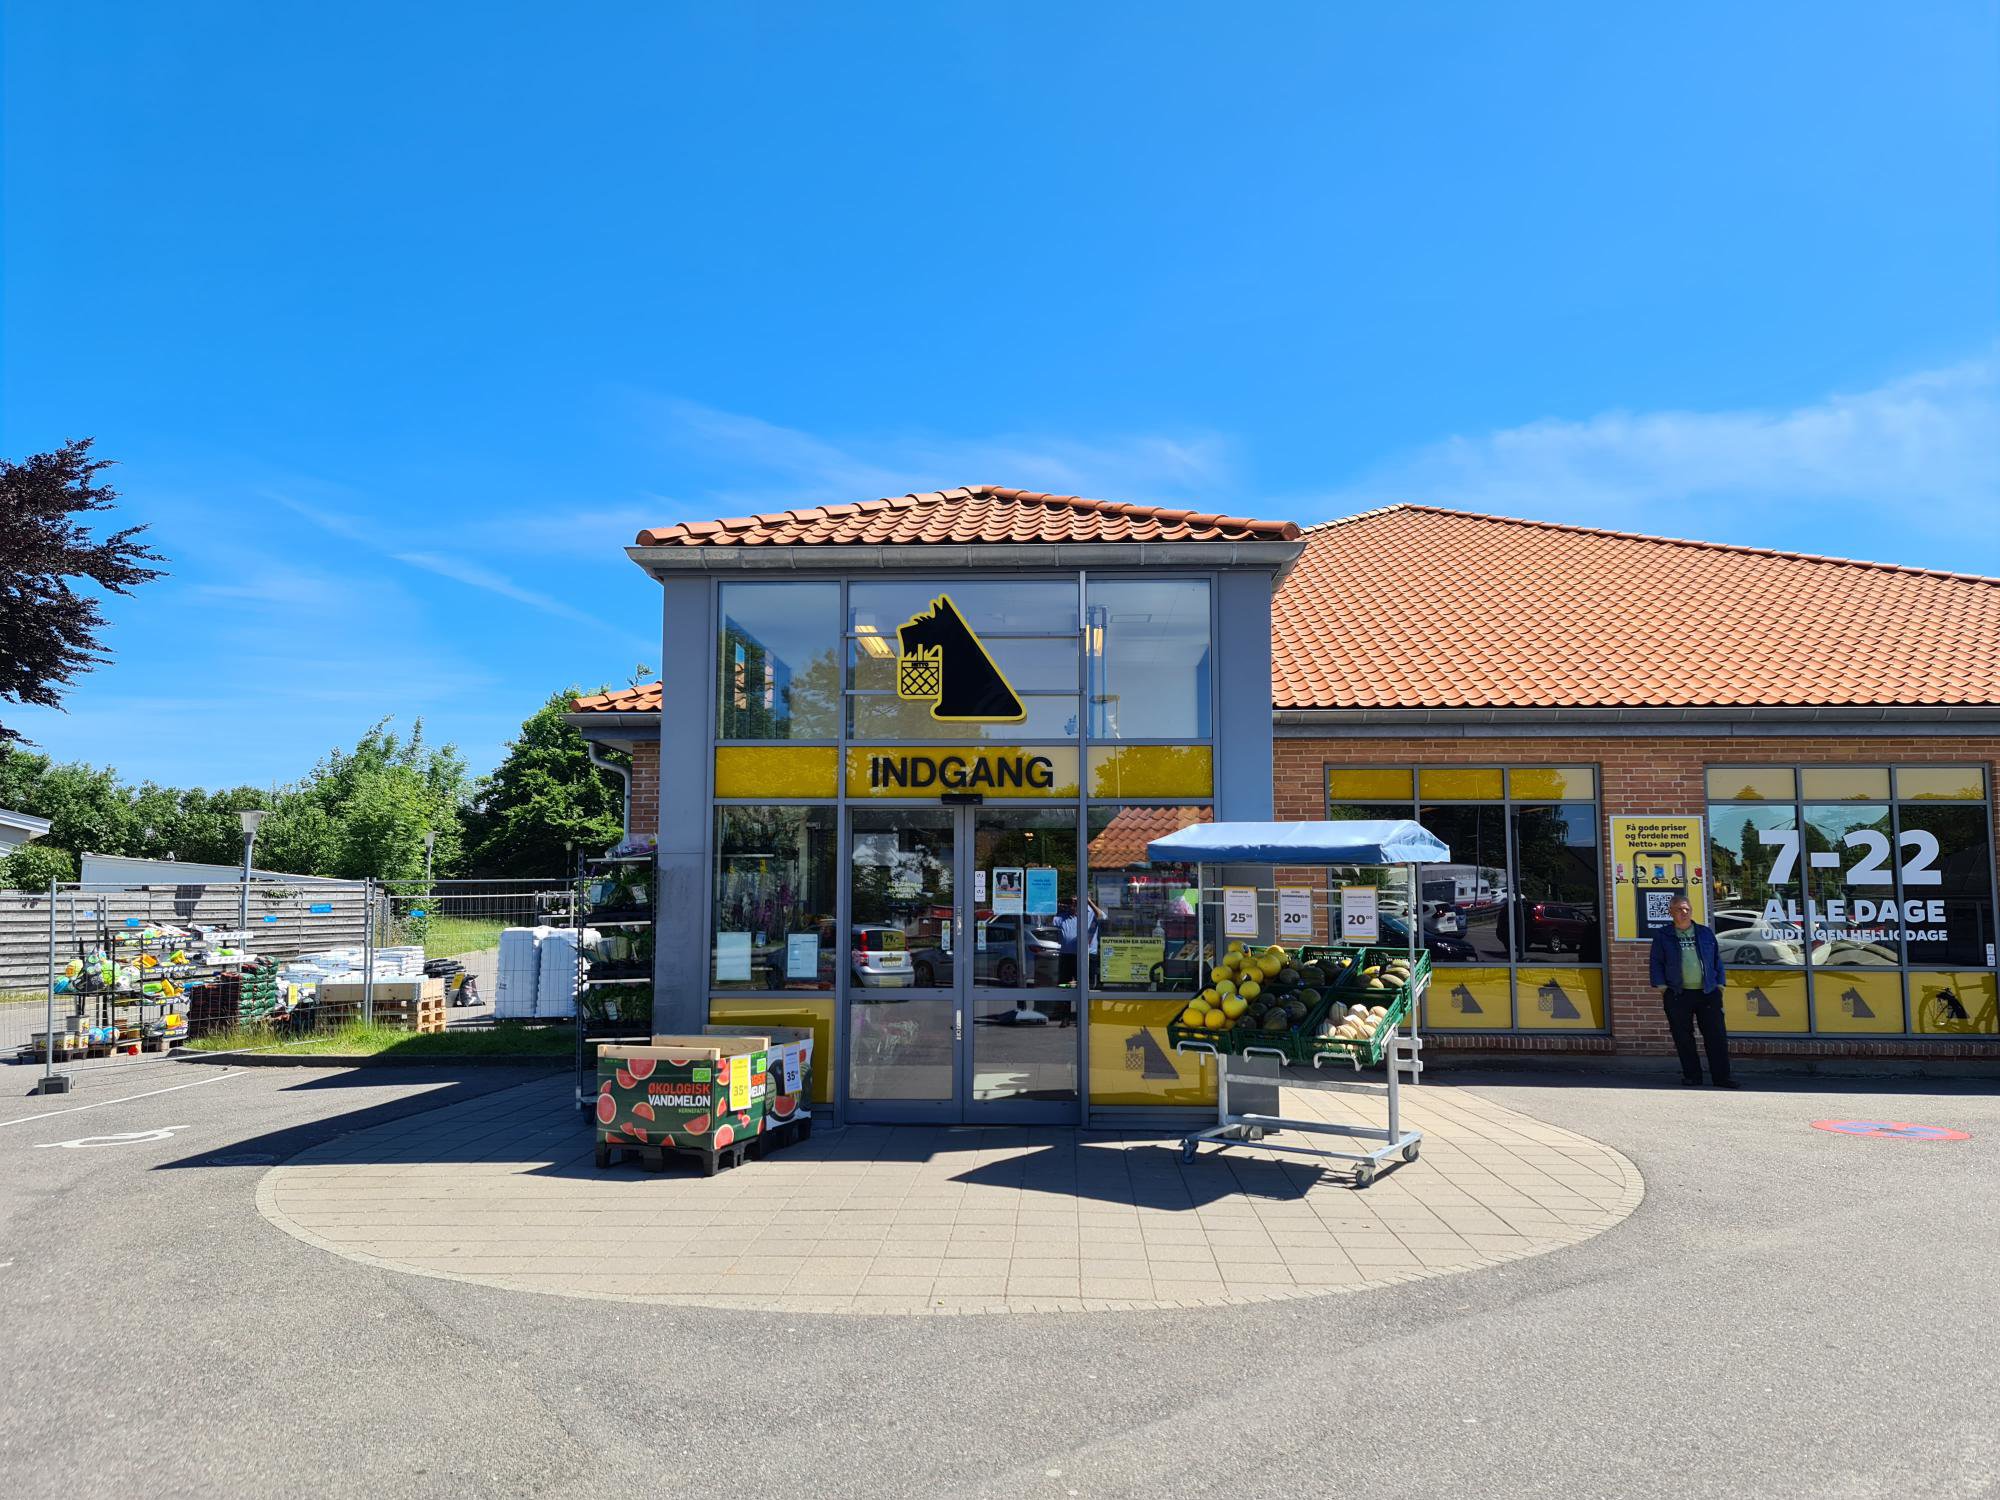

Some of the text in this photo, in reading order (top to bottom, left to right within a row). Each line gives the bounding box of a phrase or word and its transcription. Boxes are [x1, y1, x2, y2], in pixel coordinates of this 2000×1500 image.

[871, 756, 1054, 788] INDGANG
[1638, 824, 1660, 832] gode
[1661, 824, 1687, 832] priser
[1759, 829, 1942, 885] 7-22
[1762, 899, 1947, 922] ALLE DAGE
[1284, 913, 1301, 923] 20
[1348, 915, 1365, 925] 20
[1761, 929, 1848, 941] UNDTGEN
[648, 1083, 711, 1095] ØKOLOGISK
[648, 1095, 711, 1107] VANDMELON
